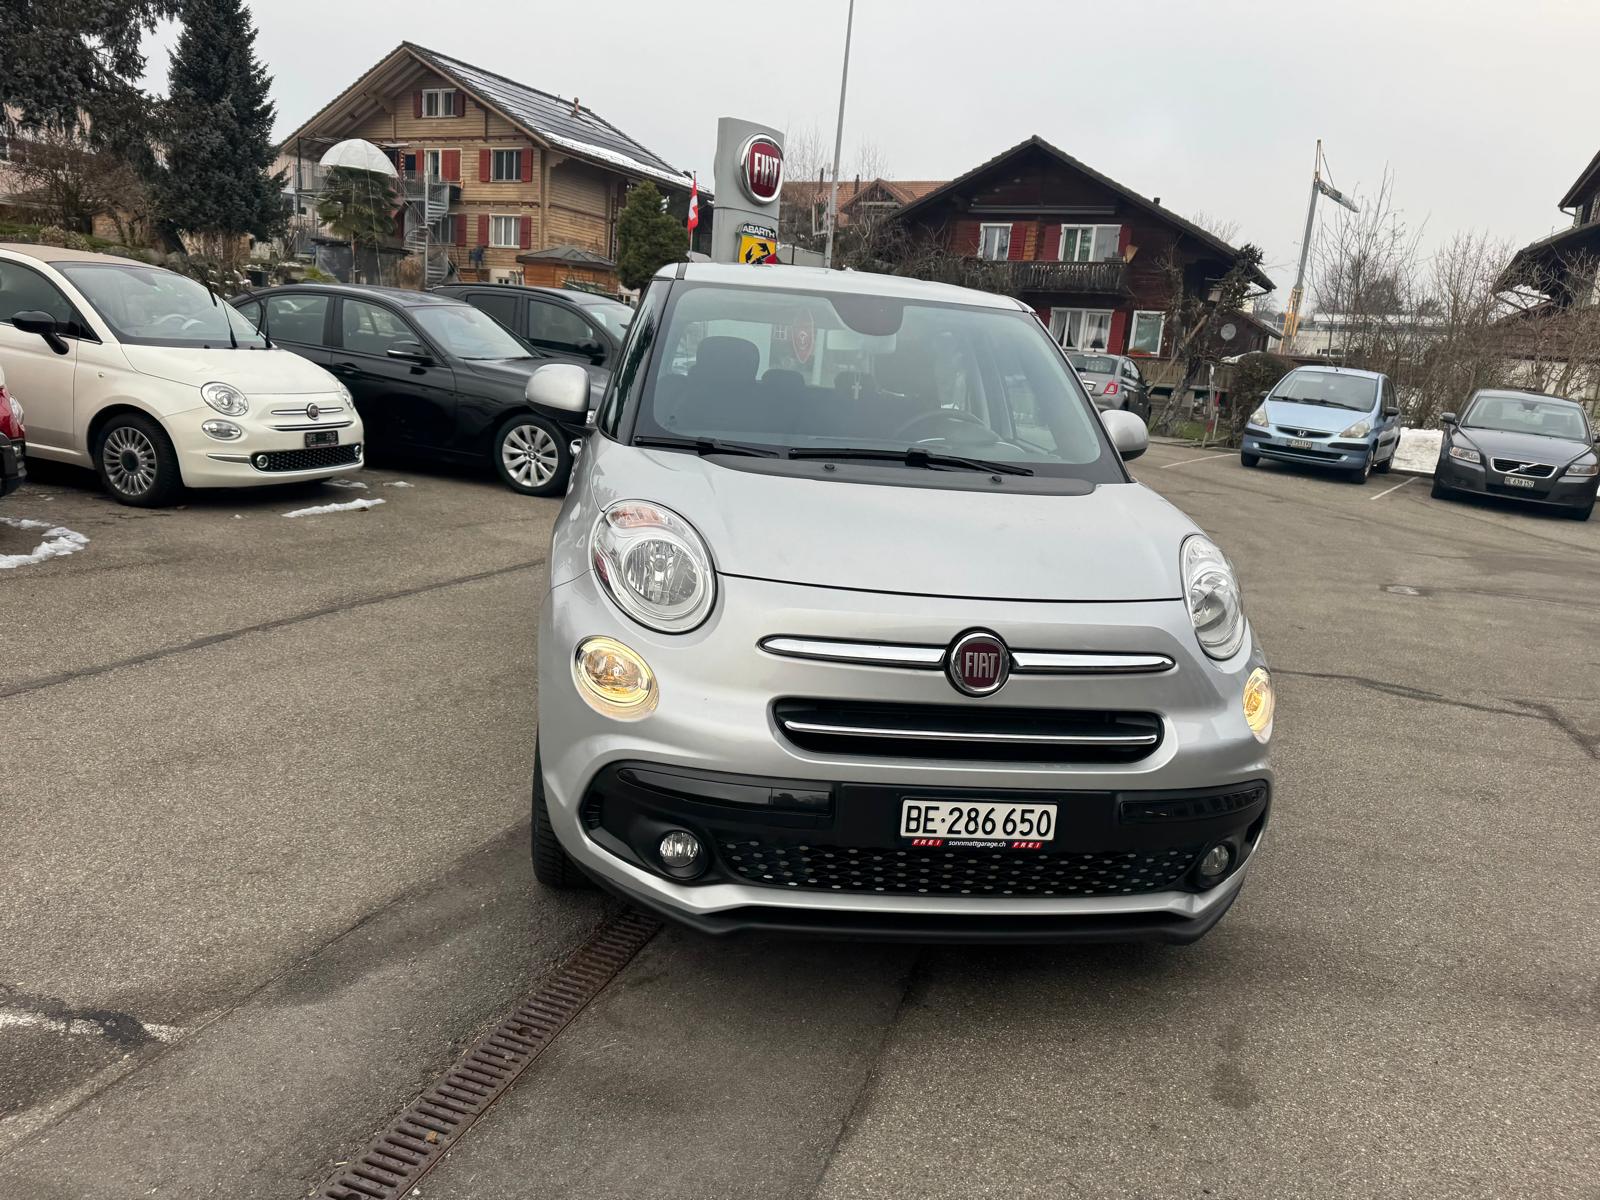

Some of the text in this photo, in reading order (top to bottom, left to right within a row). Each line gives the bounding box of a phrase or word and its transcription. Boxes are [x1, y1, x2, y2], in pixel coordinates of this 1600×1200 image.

[753, 152, 780, 188] FIAT
[742, 224, 776, 239] ABARTH
[965, 651, 998, 679] FIAT
[913, 838, 1041, 849] FREI sonnmattgarage.ch FREI
